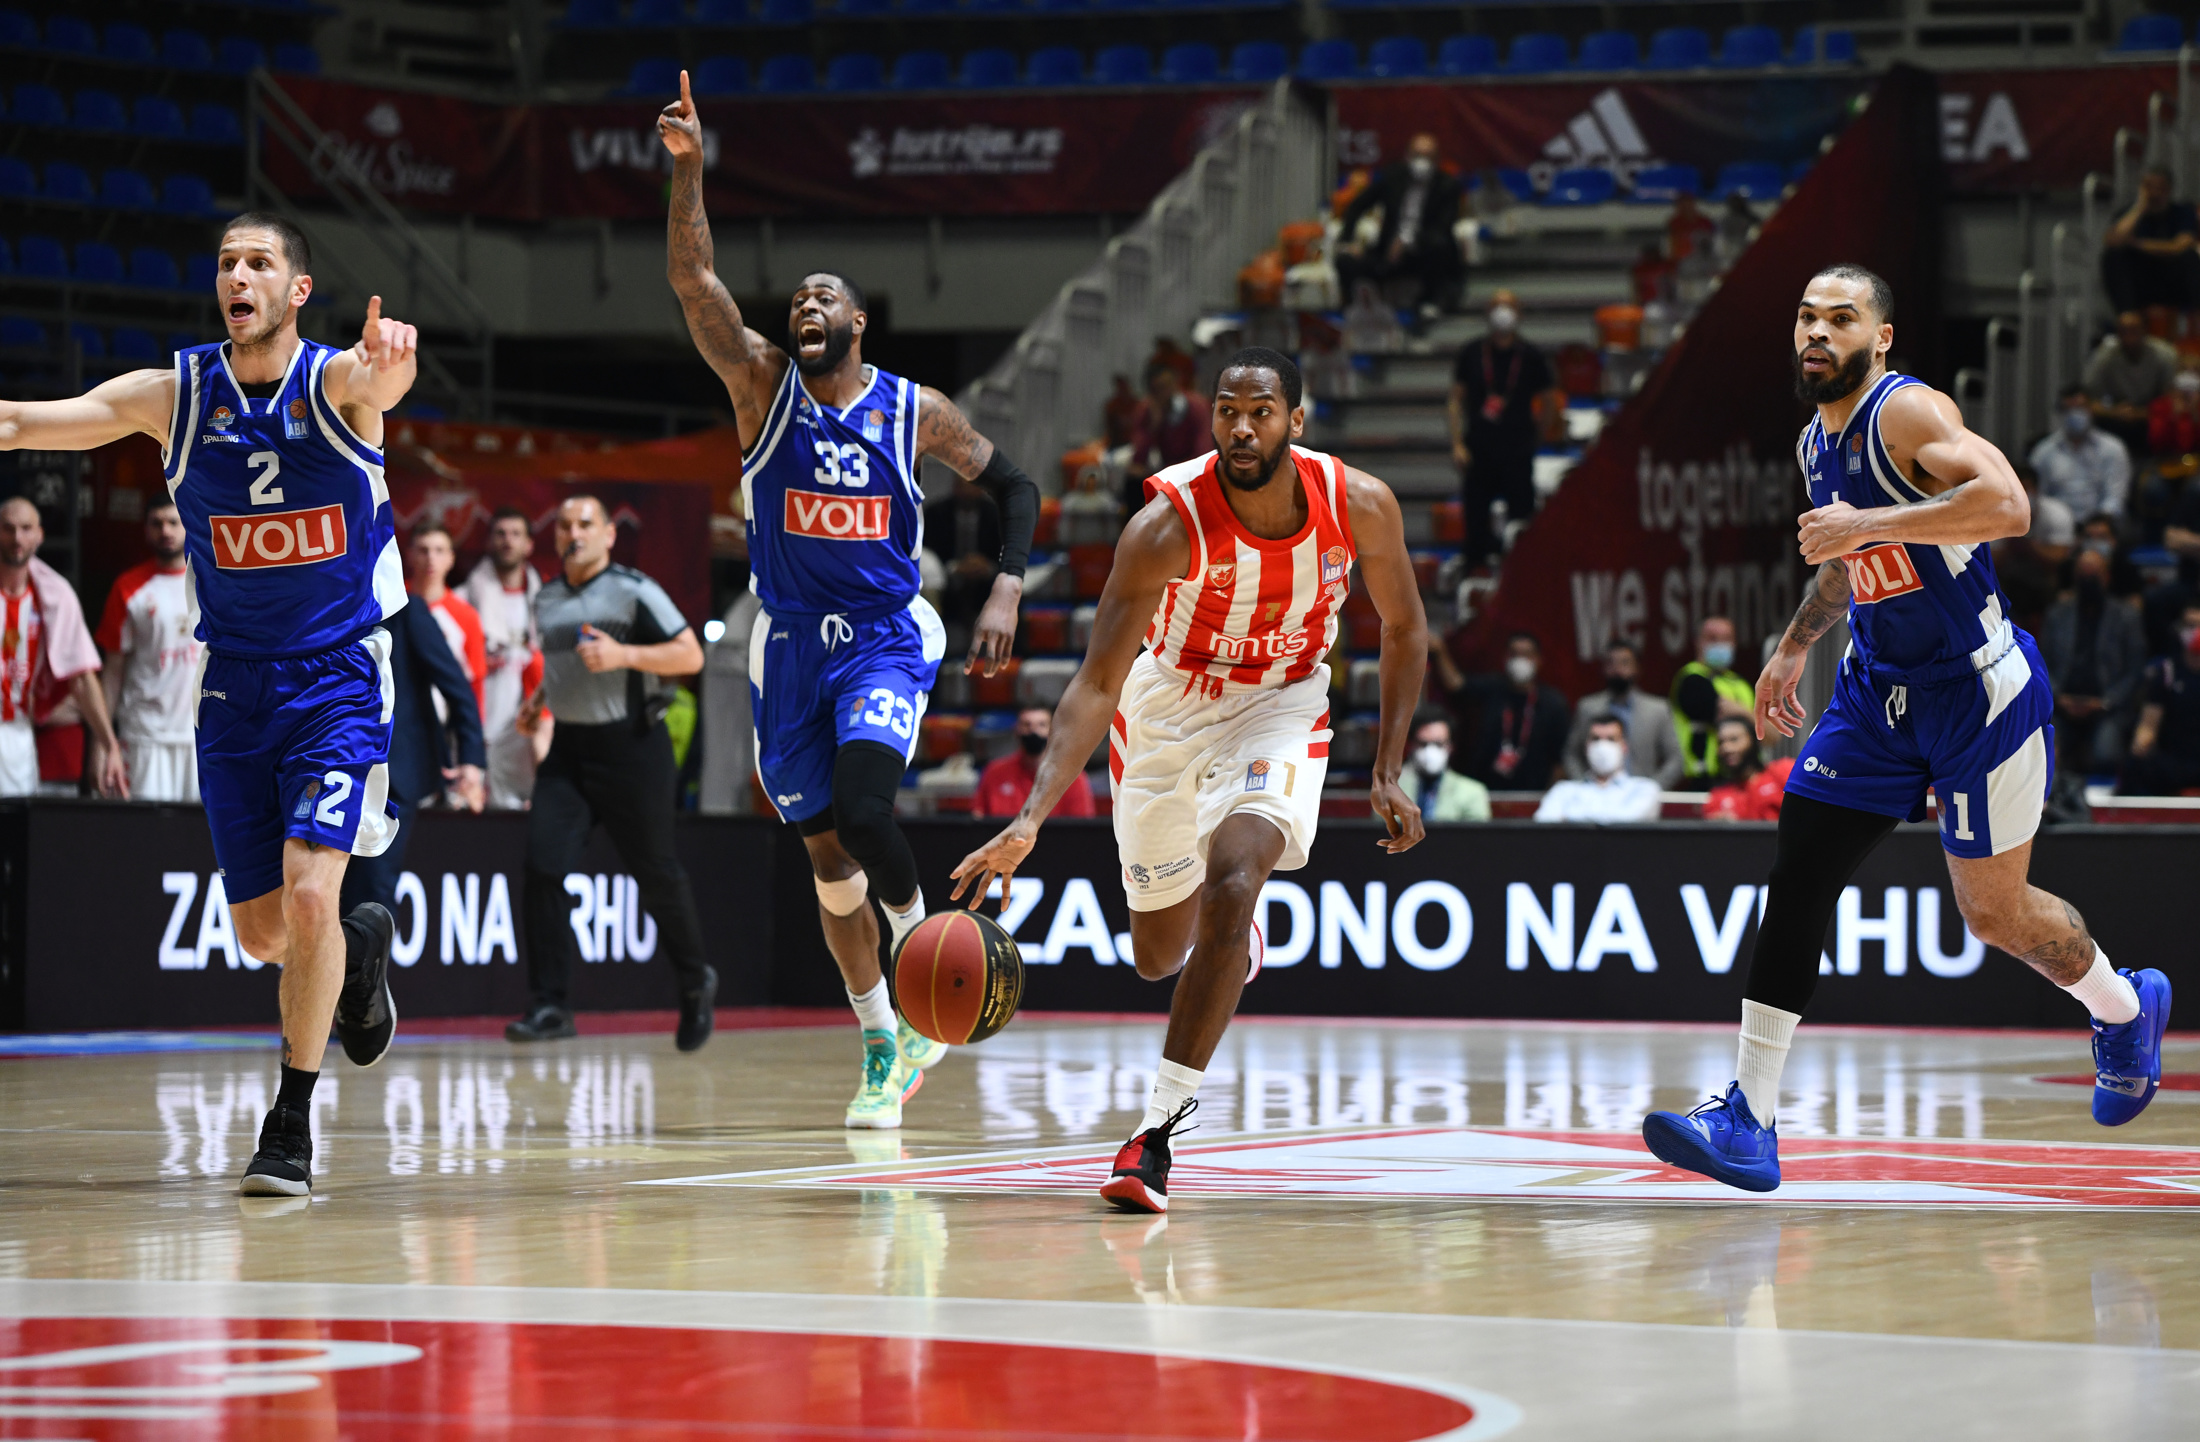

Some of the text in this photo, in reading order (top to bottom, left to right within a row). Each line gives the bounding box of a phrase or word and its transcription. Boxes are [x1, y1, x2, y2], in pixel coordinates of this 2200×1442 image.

[202, 434, 240, 445] SPALDING
[287, 421, 308, 437] ABA
[247, 450, 285, 506] 2
[814, 440, 870, 488] 33
[793, 496, 883, 535] VOLI
[219, 513, 335, 563] VOLI
[1324, 565, 1341, 581] ABA
[1847, 549, 1914, 598] VOLI
[1570, 568, 1648, 662] we
[1208, 628, 1309, 659] mts
[864, 688, 915, 740] 33
[1246, 776, 1264, 790] ABA
[1817, 763, 1838, 779] NLB
[315, 771, 353, 828] 2
[787, 792, 803, 803] NLB
[1953, 791, 1975, 841] 1
[1153, 861, 1174, 871] БАНКА
[1157, 859, 1195, 880] ШТЕДИОНИЦА
[440, 873, 518, 966] NA
[564, 873, 658, 963] RHU
[1506, 882, 1658, 972] NA
[1680, 884, 1986, 978] VHU
